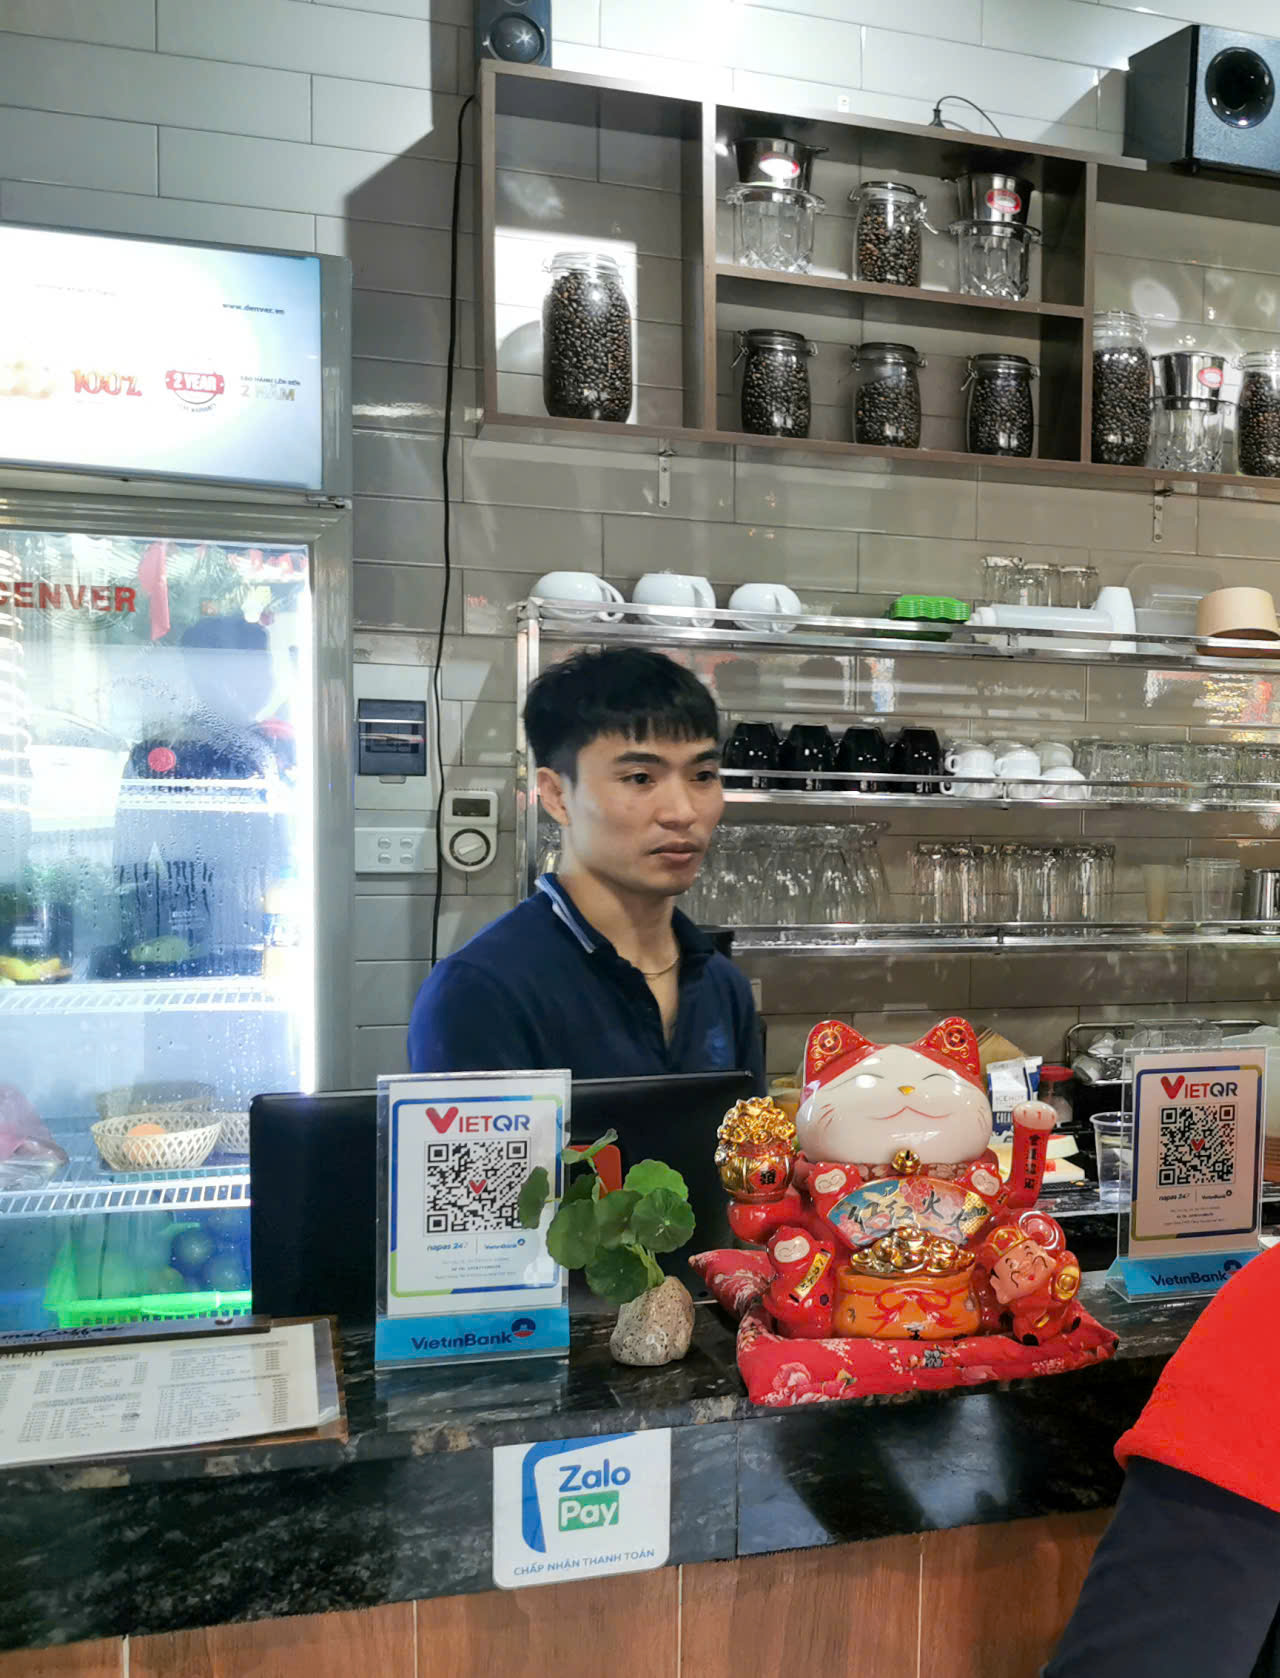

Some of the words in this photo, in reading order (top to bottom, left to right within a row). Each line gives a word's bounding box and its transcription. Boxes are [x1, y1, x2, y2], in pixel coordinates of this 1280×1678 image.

[1160, 1074, 1238, 1100] VIETQR
[425, 1106, 531, 1134] VIETQR
[1151, 1267, 1228, 1287] VietinBank
[411, 1331, 512, 1351] VietinBank
[558, 1458, 631, 1493] Zalo
[560, 1500, 618, 1528] Pay
[513, 1561, 545, 1576] CHẤP
[582, 1552, 622, 1567] THANH
[625, 1548, 655, 1561] TOÁN
